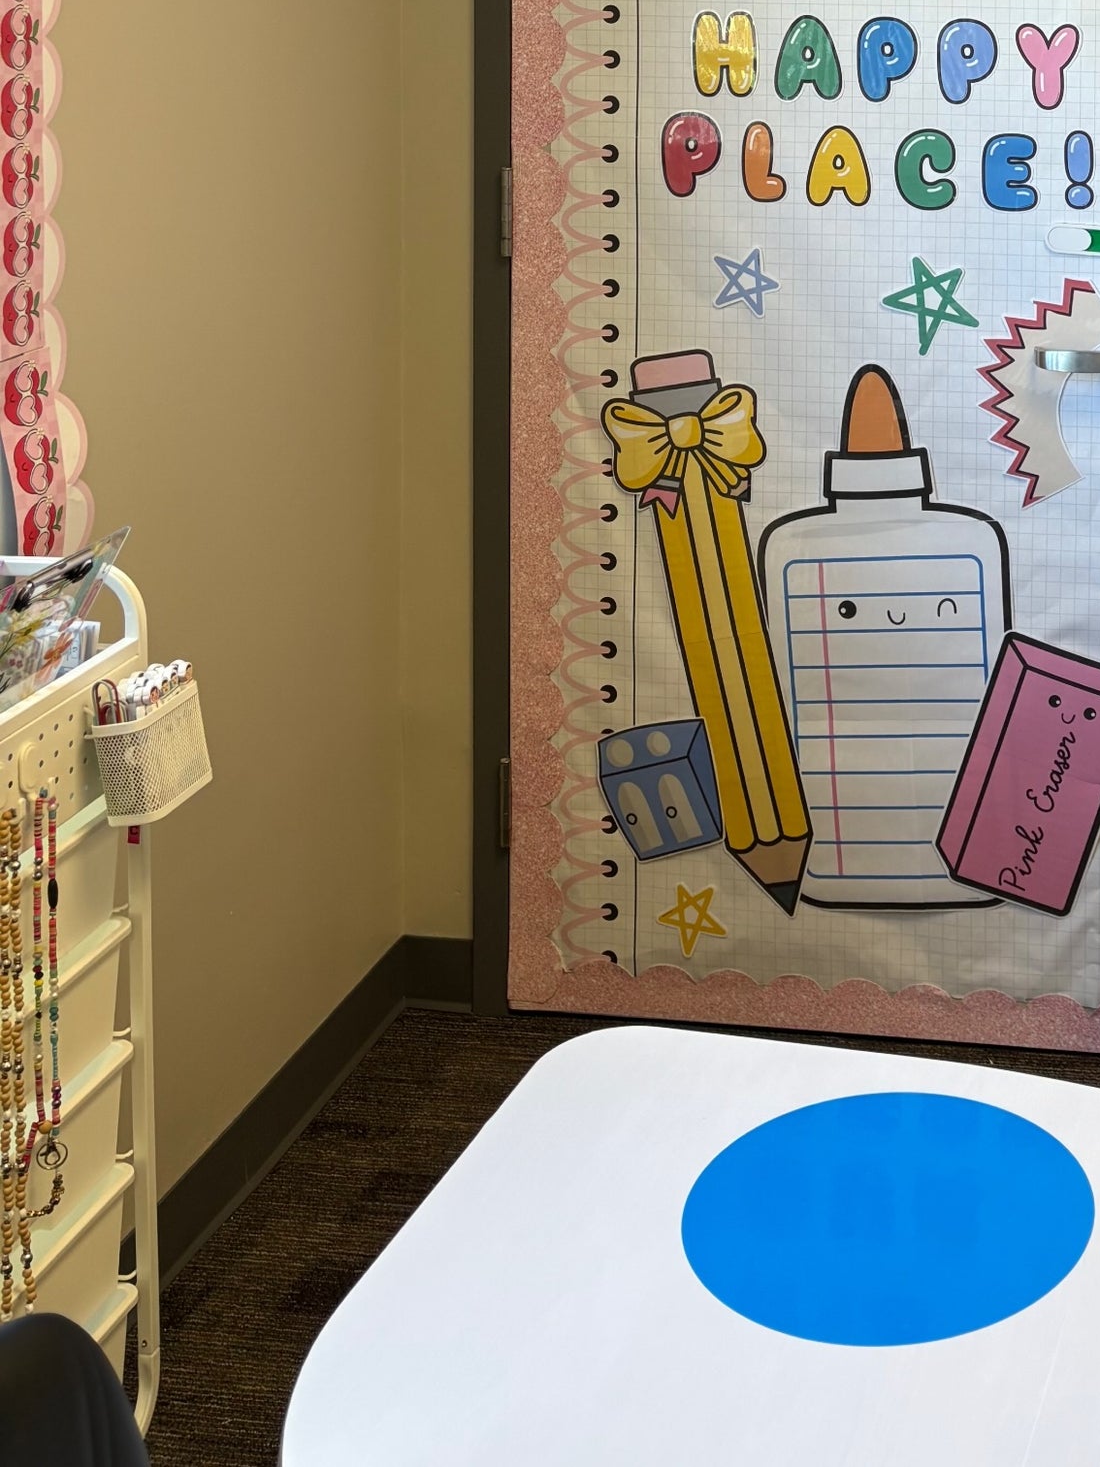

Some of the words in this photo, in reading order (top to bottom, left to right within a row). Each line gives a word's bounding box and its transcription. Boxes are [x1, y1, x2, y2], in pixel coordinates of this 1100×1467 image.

[693, 10, 1080, 110] HAPPY
[661, 111, 1094, 211] PLACE!
[998, 825, 1044, 892] Pink
[1026, 732, 1076, 813] Eraser
